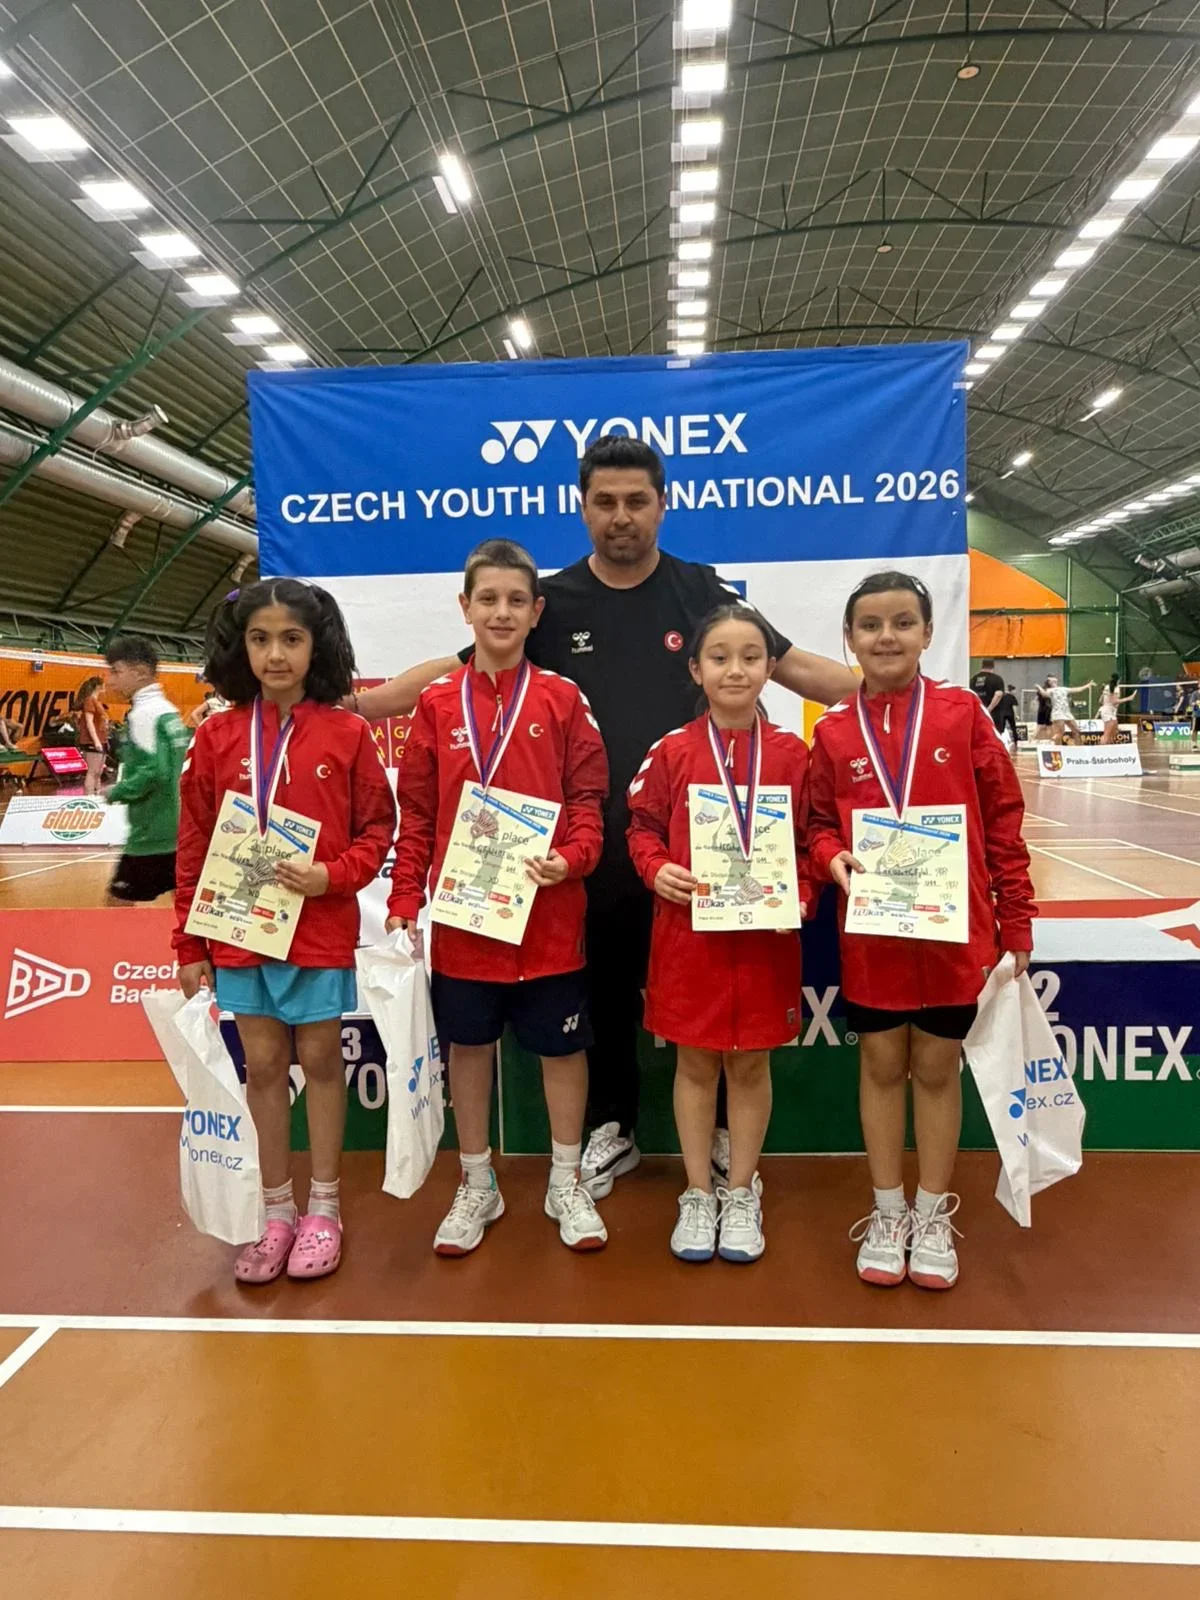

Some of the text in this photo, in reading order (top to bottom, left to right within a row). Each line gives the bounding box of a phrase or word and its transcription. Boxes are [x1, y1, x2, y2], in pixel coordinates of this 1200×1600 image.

[281, 469, 960, 524] CZECH YOUTH INNATIONAL 2026
[937, 816, 960, 824] YONEX
[502, 831, 530, 845] place
[341, 1026, 362, 1062] 3
